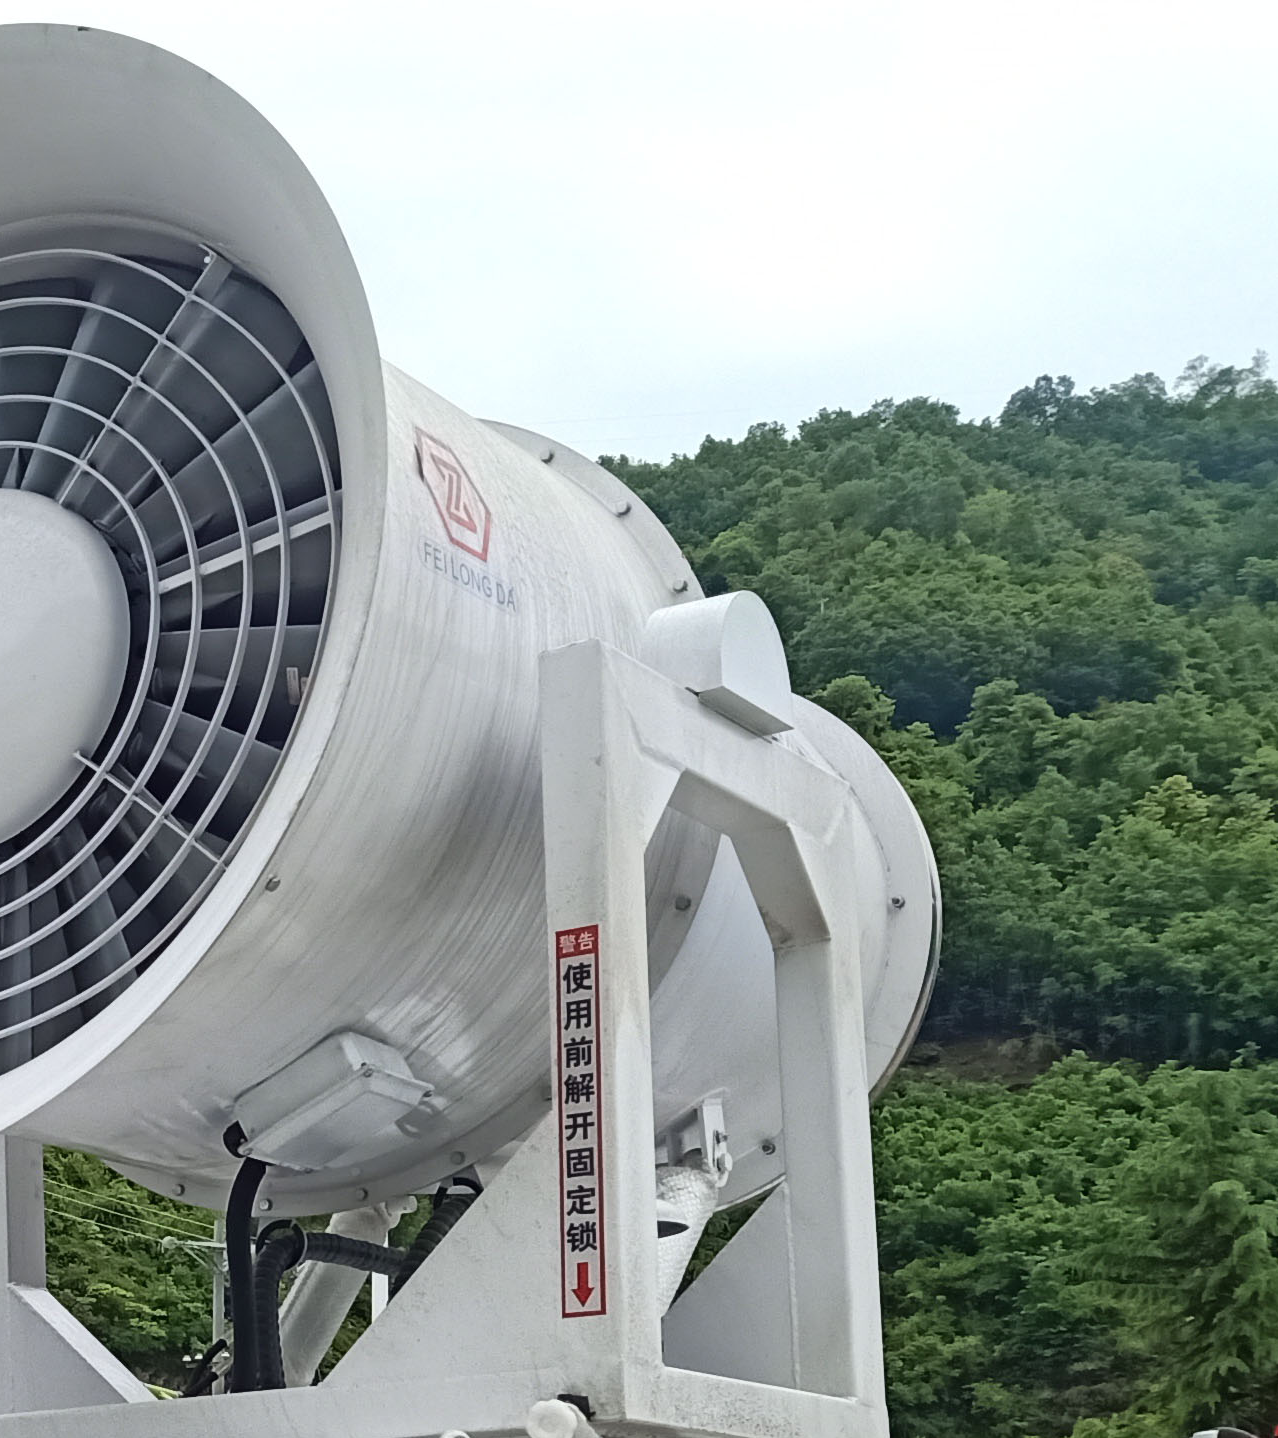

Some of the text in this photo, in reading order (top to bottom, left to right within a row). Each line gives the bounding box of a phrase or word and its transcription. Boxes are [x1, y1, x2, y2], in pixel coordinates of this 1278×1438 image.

[558, 931, 595, 954] 警告
[562, 962, 598, 1253] 使用前解开固定锁
